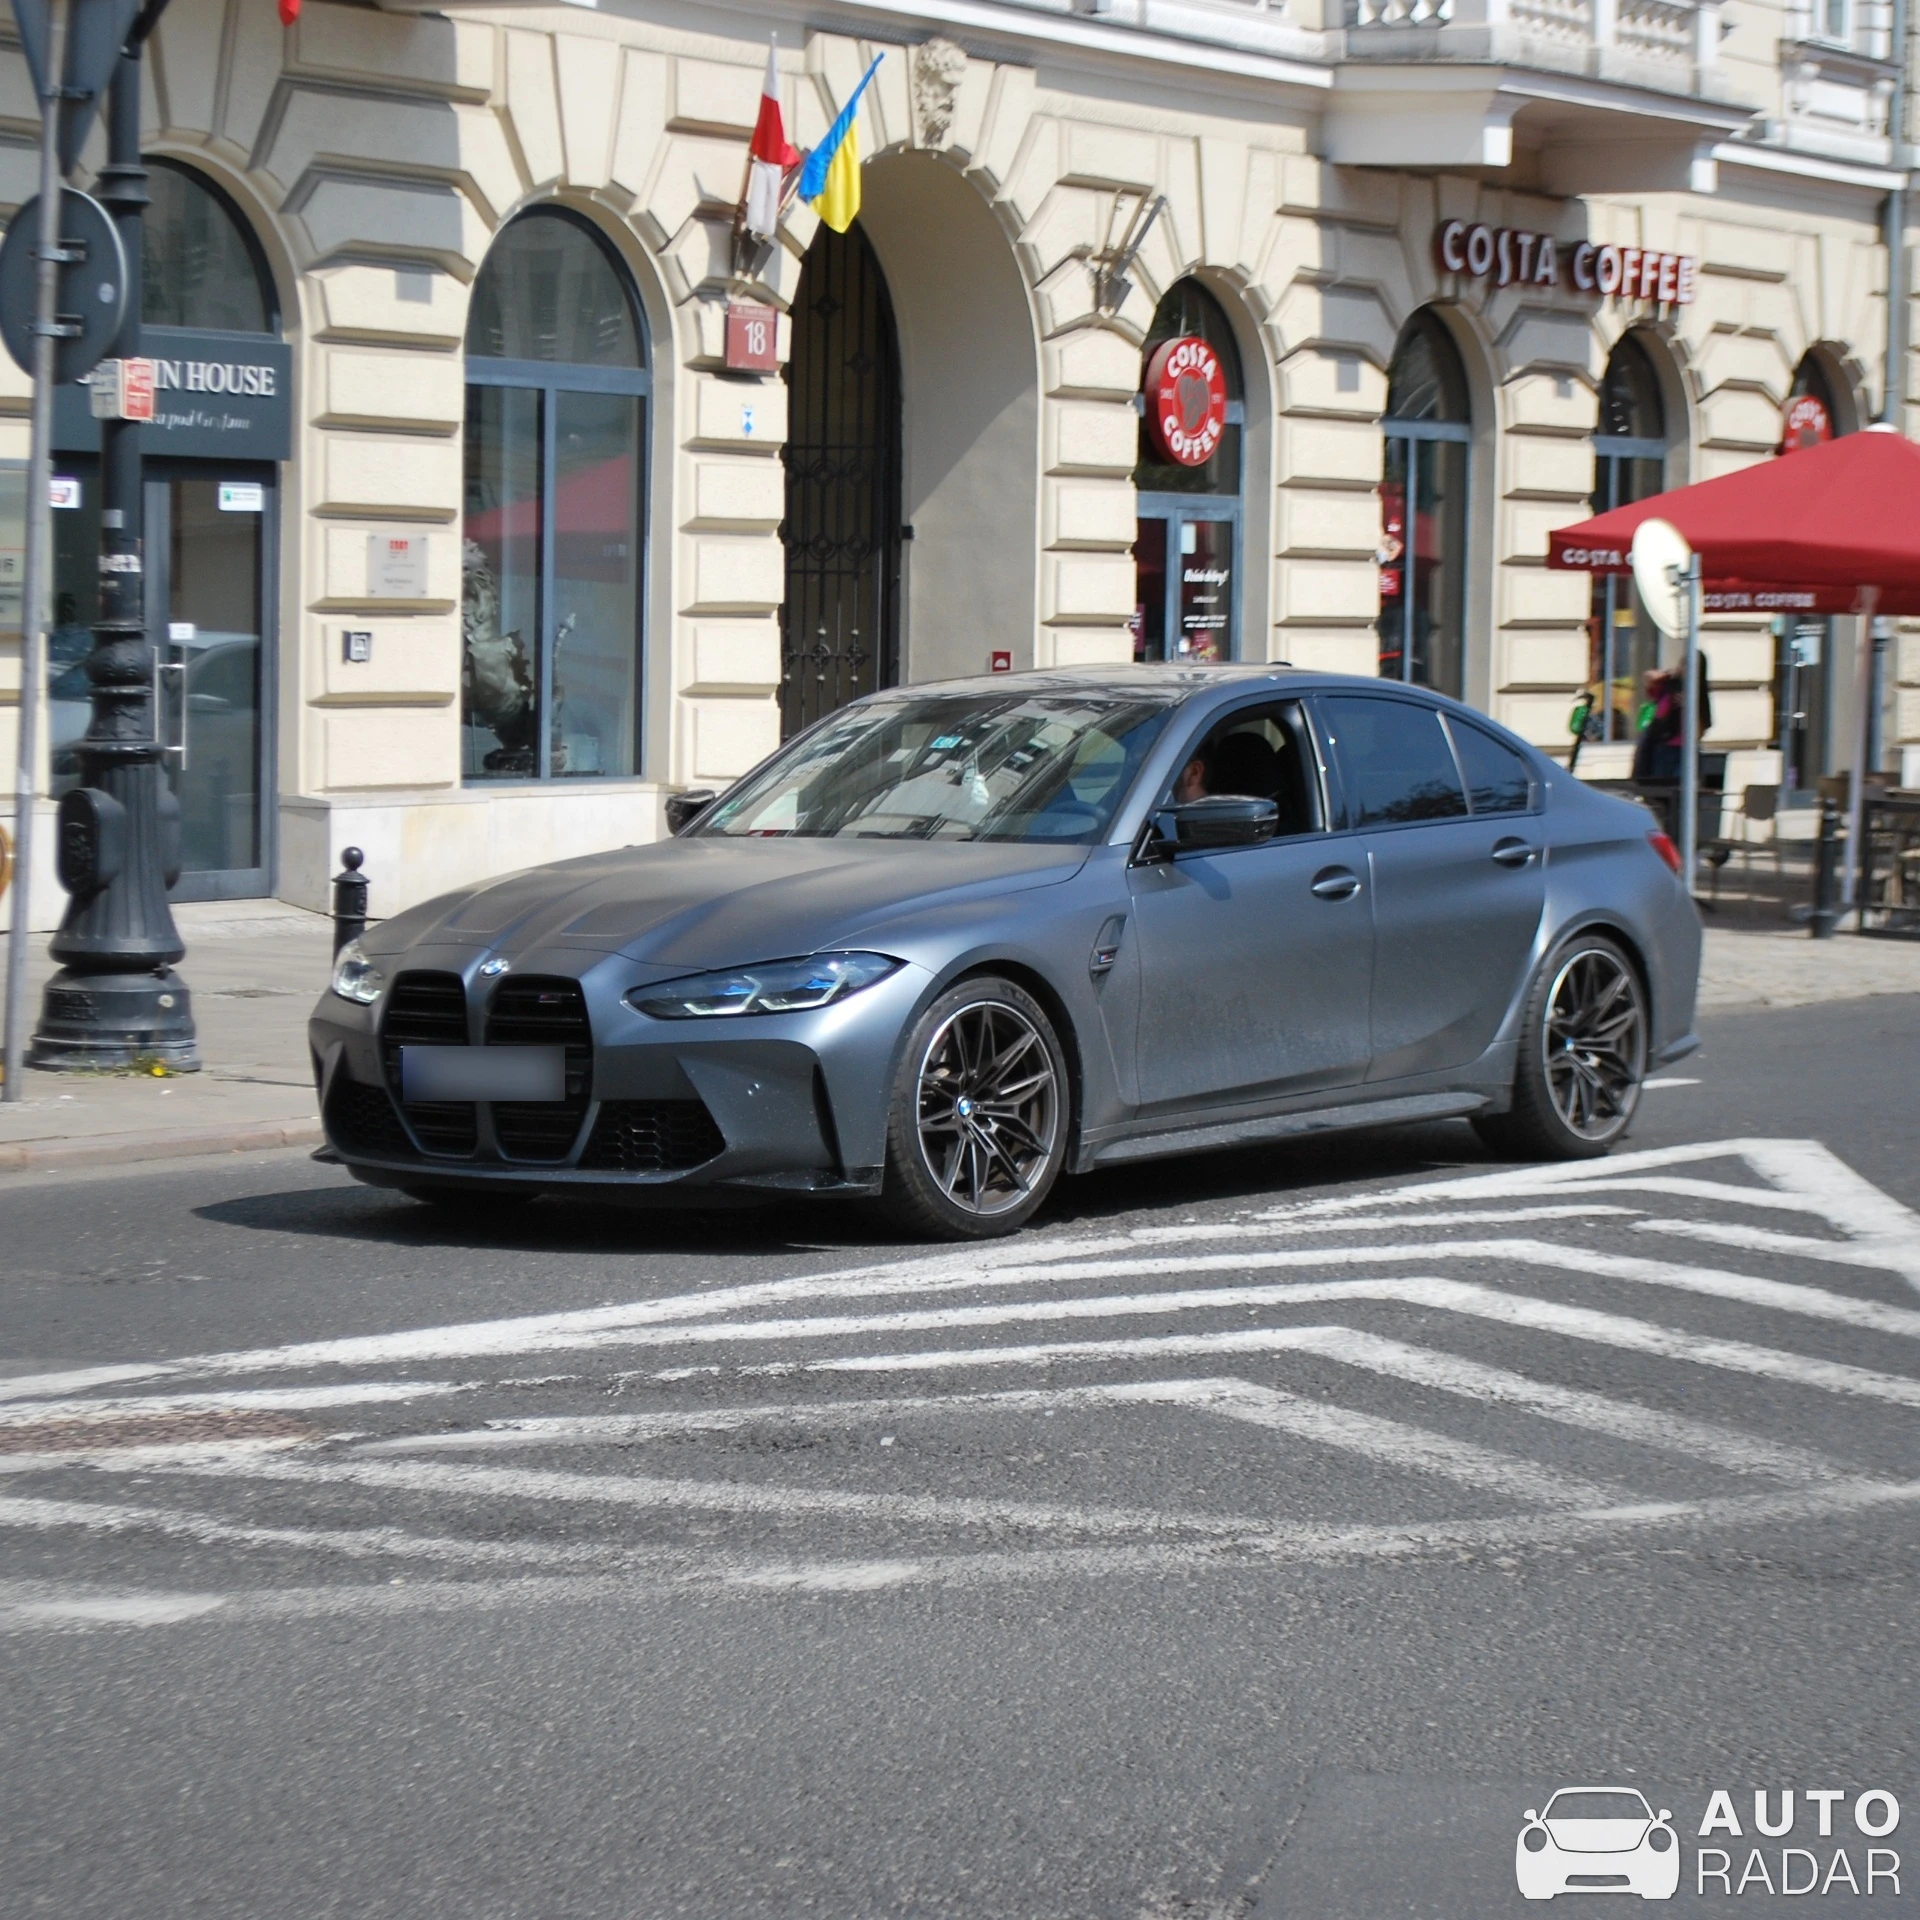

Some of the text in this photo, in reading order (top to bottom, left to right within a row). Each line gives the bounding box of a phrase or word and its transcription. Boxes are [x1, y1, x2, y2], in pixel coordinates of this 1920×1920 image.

[1440, 219, 1697, 304] COSTA COFFEE
[744, 320, 766, 355] 18
[184, 361, 276, 397] HOUSE
[1167, 343, 1217, 382] COSTA
[1164, 415, 1221, 460] COFFEE
[1561, 547, 1622, 567] COSTA
